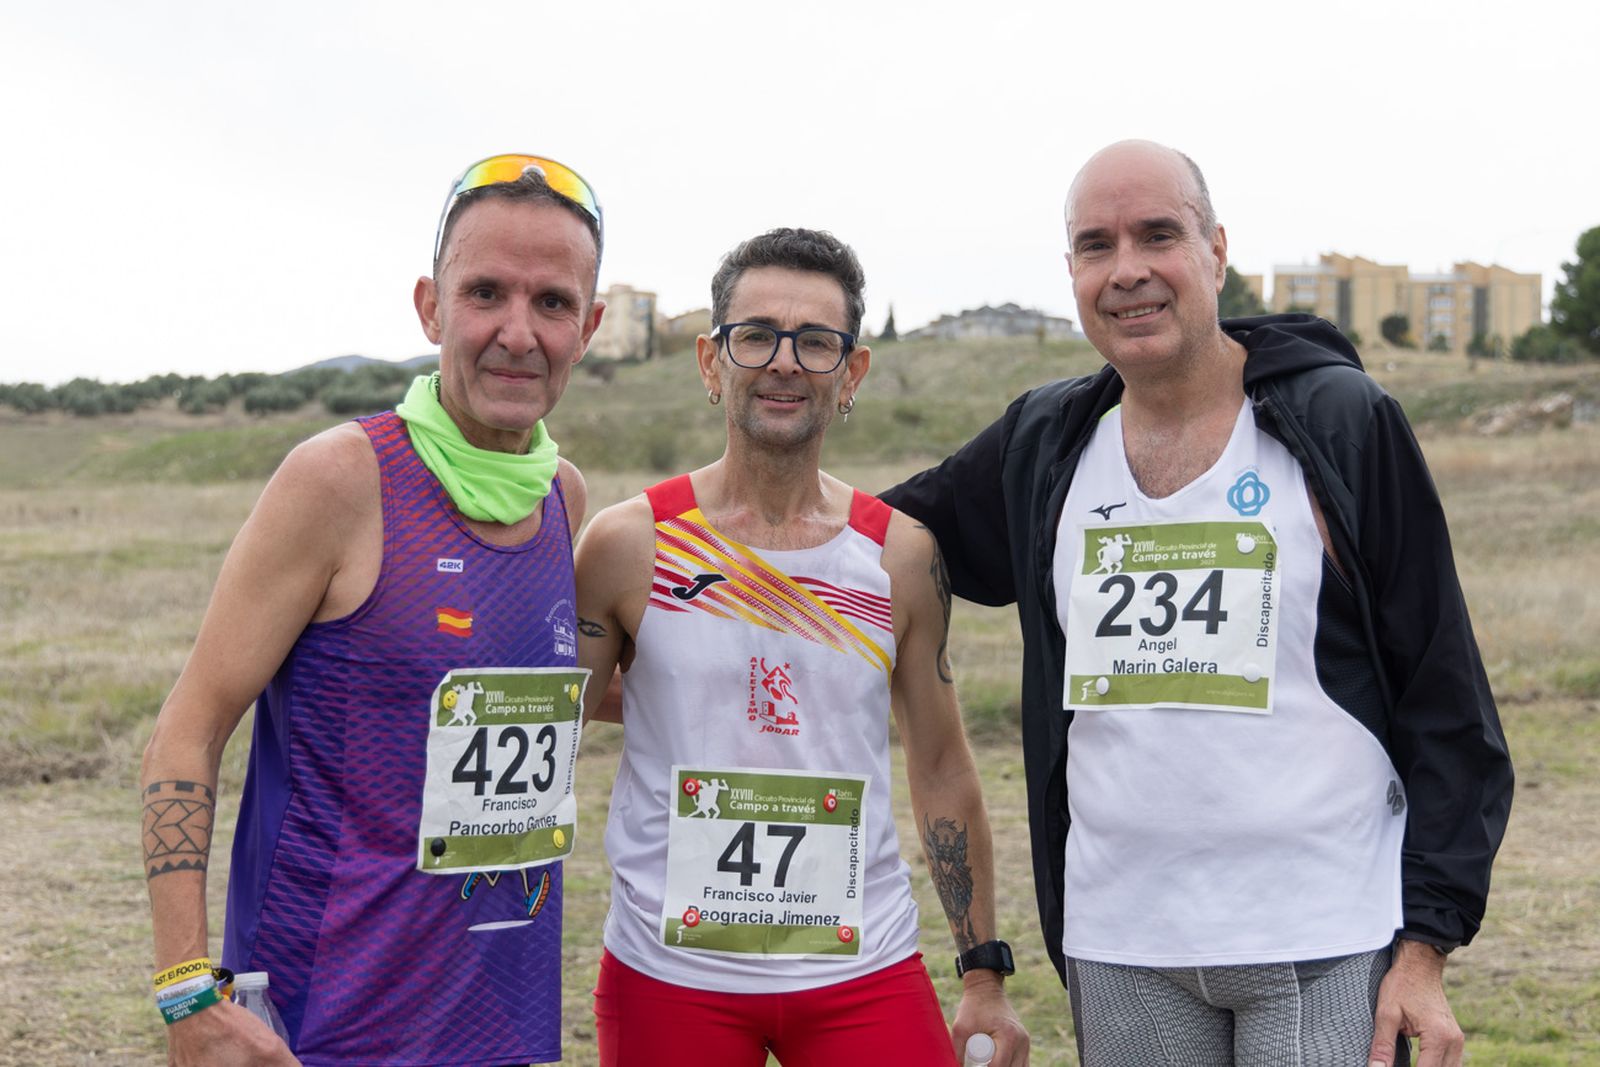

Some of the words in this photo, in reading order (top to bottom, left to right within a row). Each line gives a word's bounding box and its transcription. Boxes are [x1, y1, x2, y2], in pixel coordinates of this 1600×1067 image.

[1133, 541, 1155, 553] XXVIII
[1179, 543, 1206, 551] Provincial
[1132, 553, 1168, 563] Campo
[1172, 552, 1178, 560] a
[1182, 549, 1216, 560] través
[439, 561, 461, 569] 42K
[1095, 570, 1228, 637] 234
[1257, 552, 1275, 647] Discapacitado
[1138, 638, 1177, 653] Angel
[1113, 659, 1156, 674] Marin
[1162, 657, 1218, 674] Galera
[747, 657, 758, 721] ATLETISMO
[486, 704, 517, 716] Campo
[520, 705, 525, 713] a
[528, 703, 554, 713] través
[759, 725, 799, 736] JODAR
[452, 725, 557, 796] 423
[731, 789, 753, 800] XXVIII
[779, 796, 807, 804] Provincial
[482, 797, 537, 812] Francisco
[730, 800, 769, 813] Campo
[772, 804, 778, 812] a
[782, 803, 816, 814] través
[450, 819, 524, 836] Pancorbo
[717, 822, 806, 887] 47
[847, 808, 859, 899] Discapacitado
[703, 887, 774, 902] Francisco
[779, 890, 817, 904] Javier
[778, 910, 840, 926] Jimenez
[176, 962, 202, 977] FOOD
[172, 1008, 192, 1020] CIVIL
